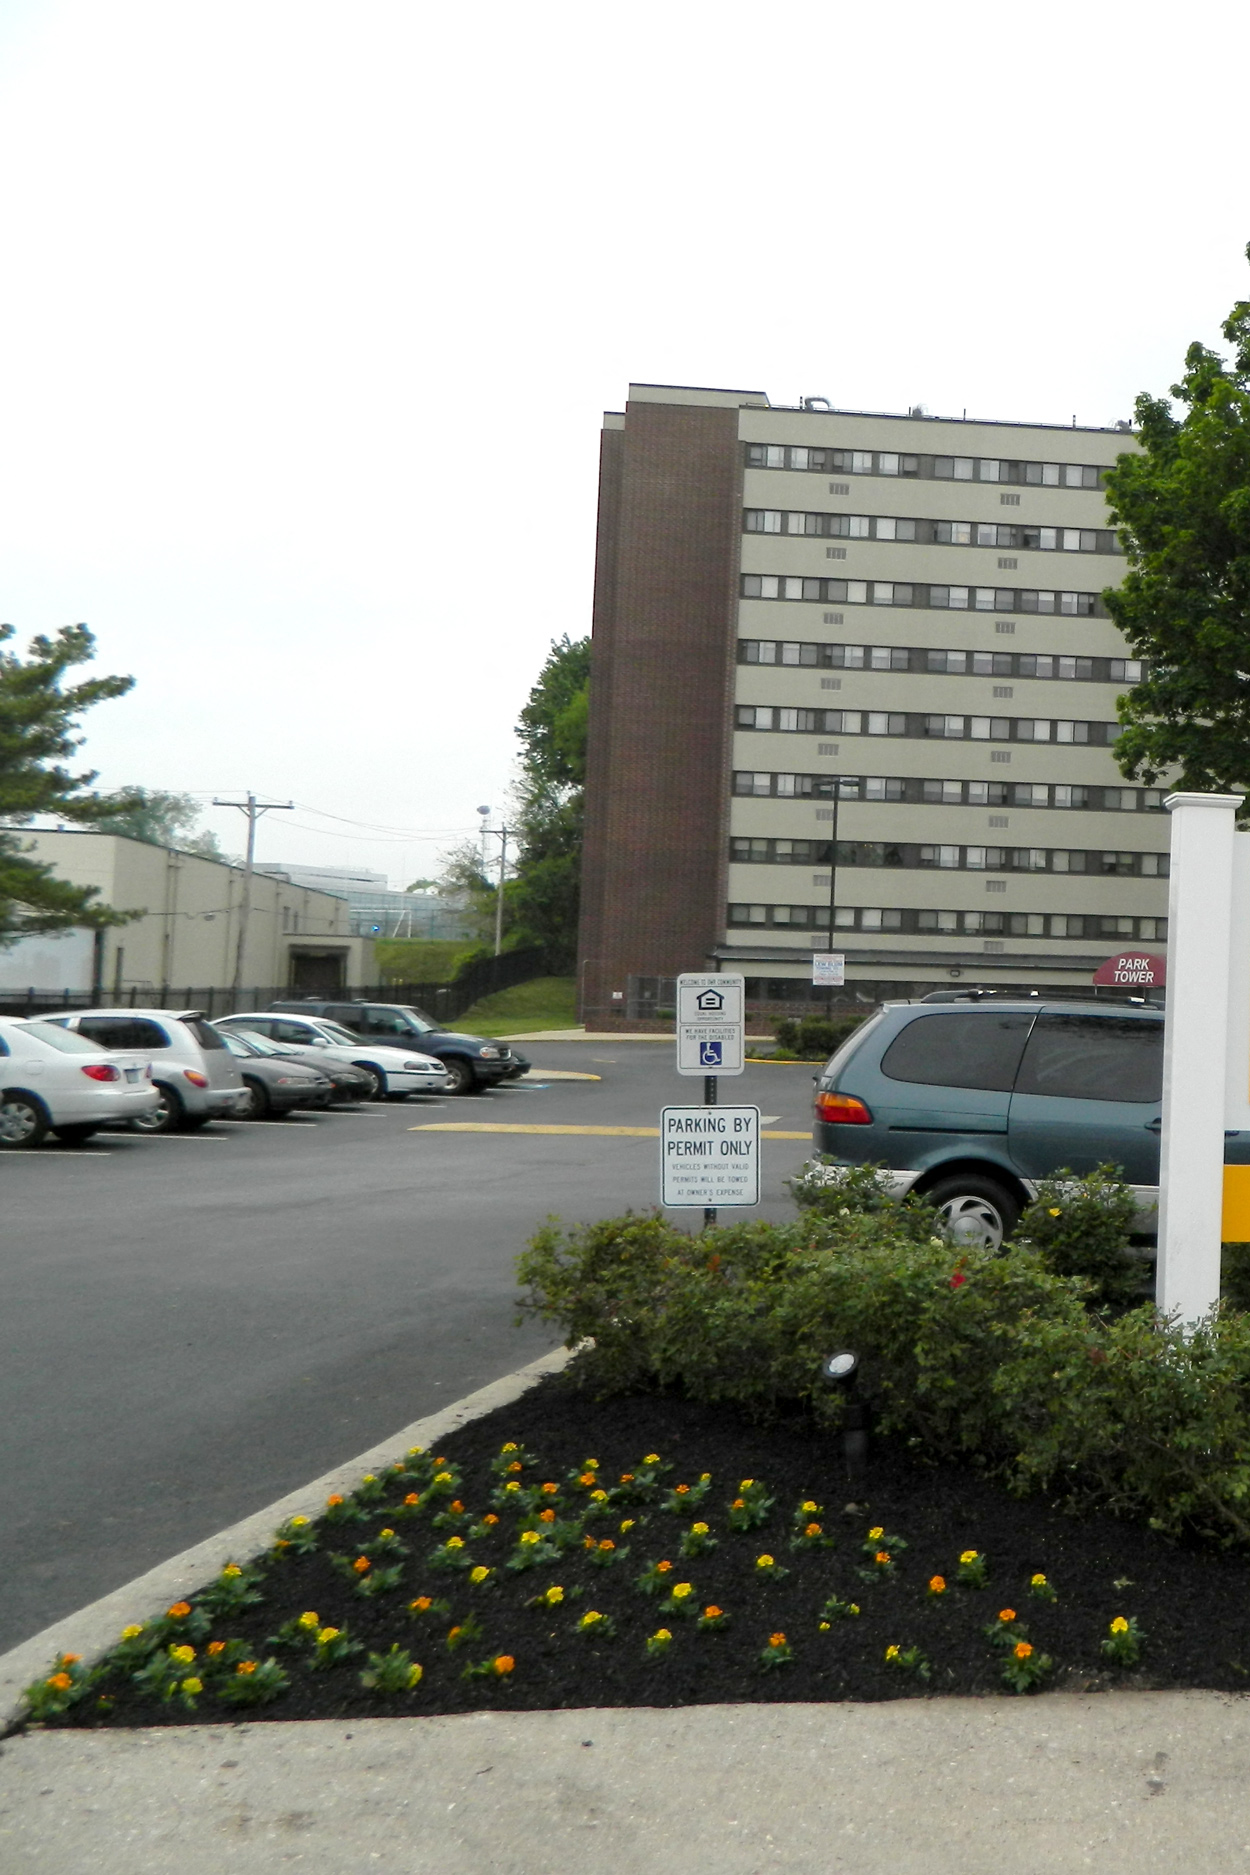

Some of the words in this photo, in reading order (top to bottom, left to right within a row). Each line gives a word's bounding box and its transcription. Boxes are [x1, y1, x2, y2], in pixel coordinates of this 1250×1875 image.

[1118, 958, 1150, 970] PARK
[1114, 970, 1154, 983] TOWER
[668, 1118, 726, 1133] PARKING
[734, 1117, 752, 1132] BY
[667, 1141, 714, 1156] PERMIT
[720, 1140, 753, 1156] ONLY
